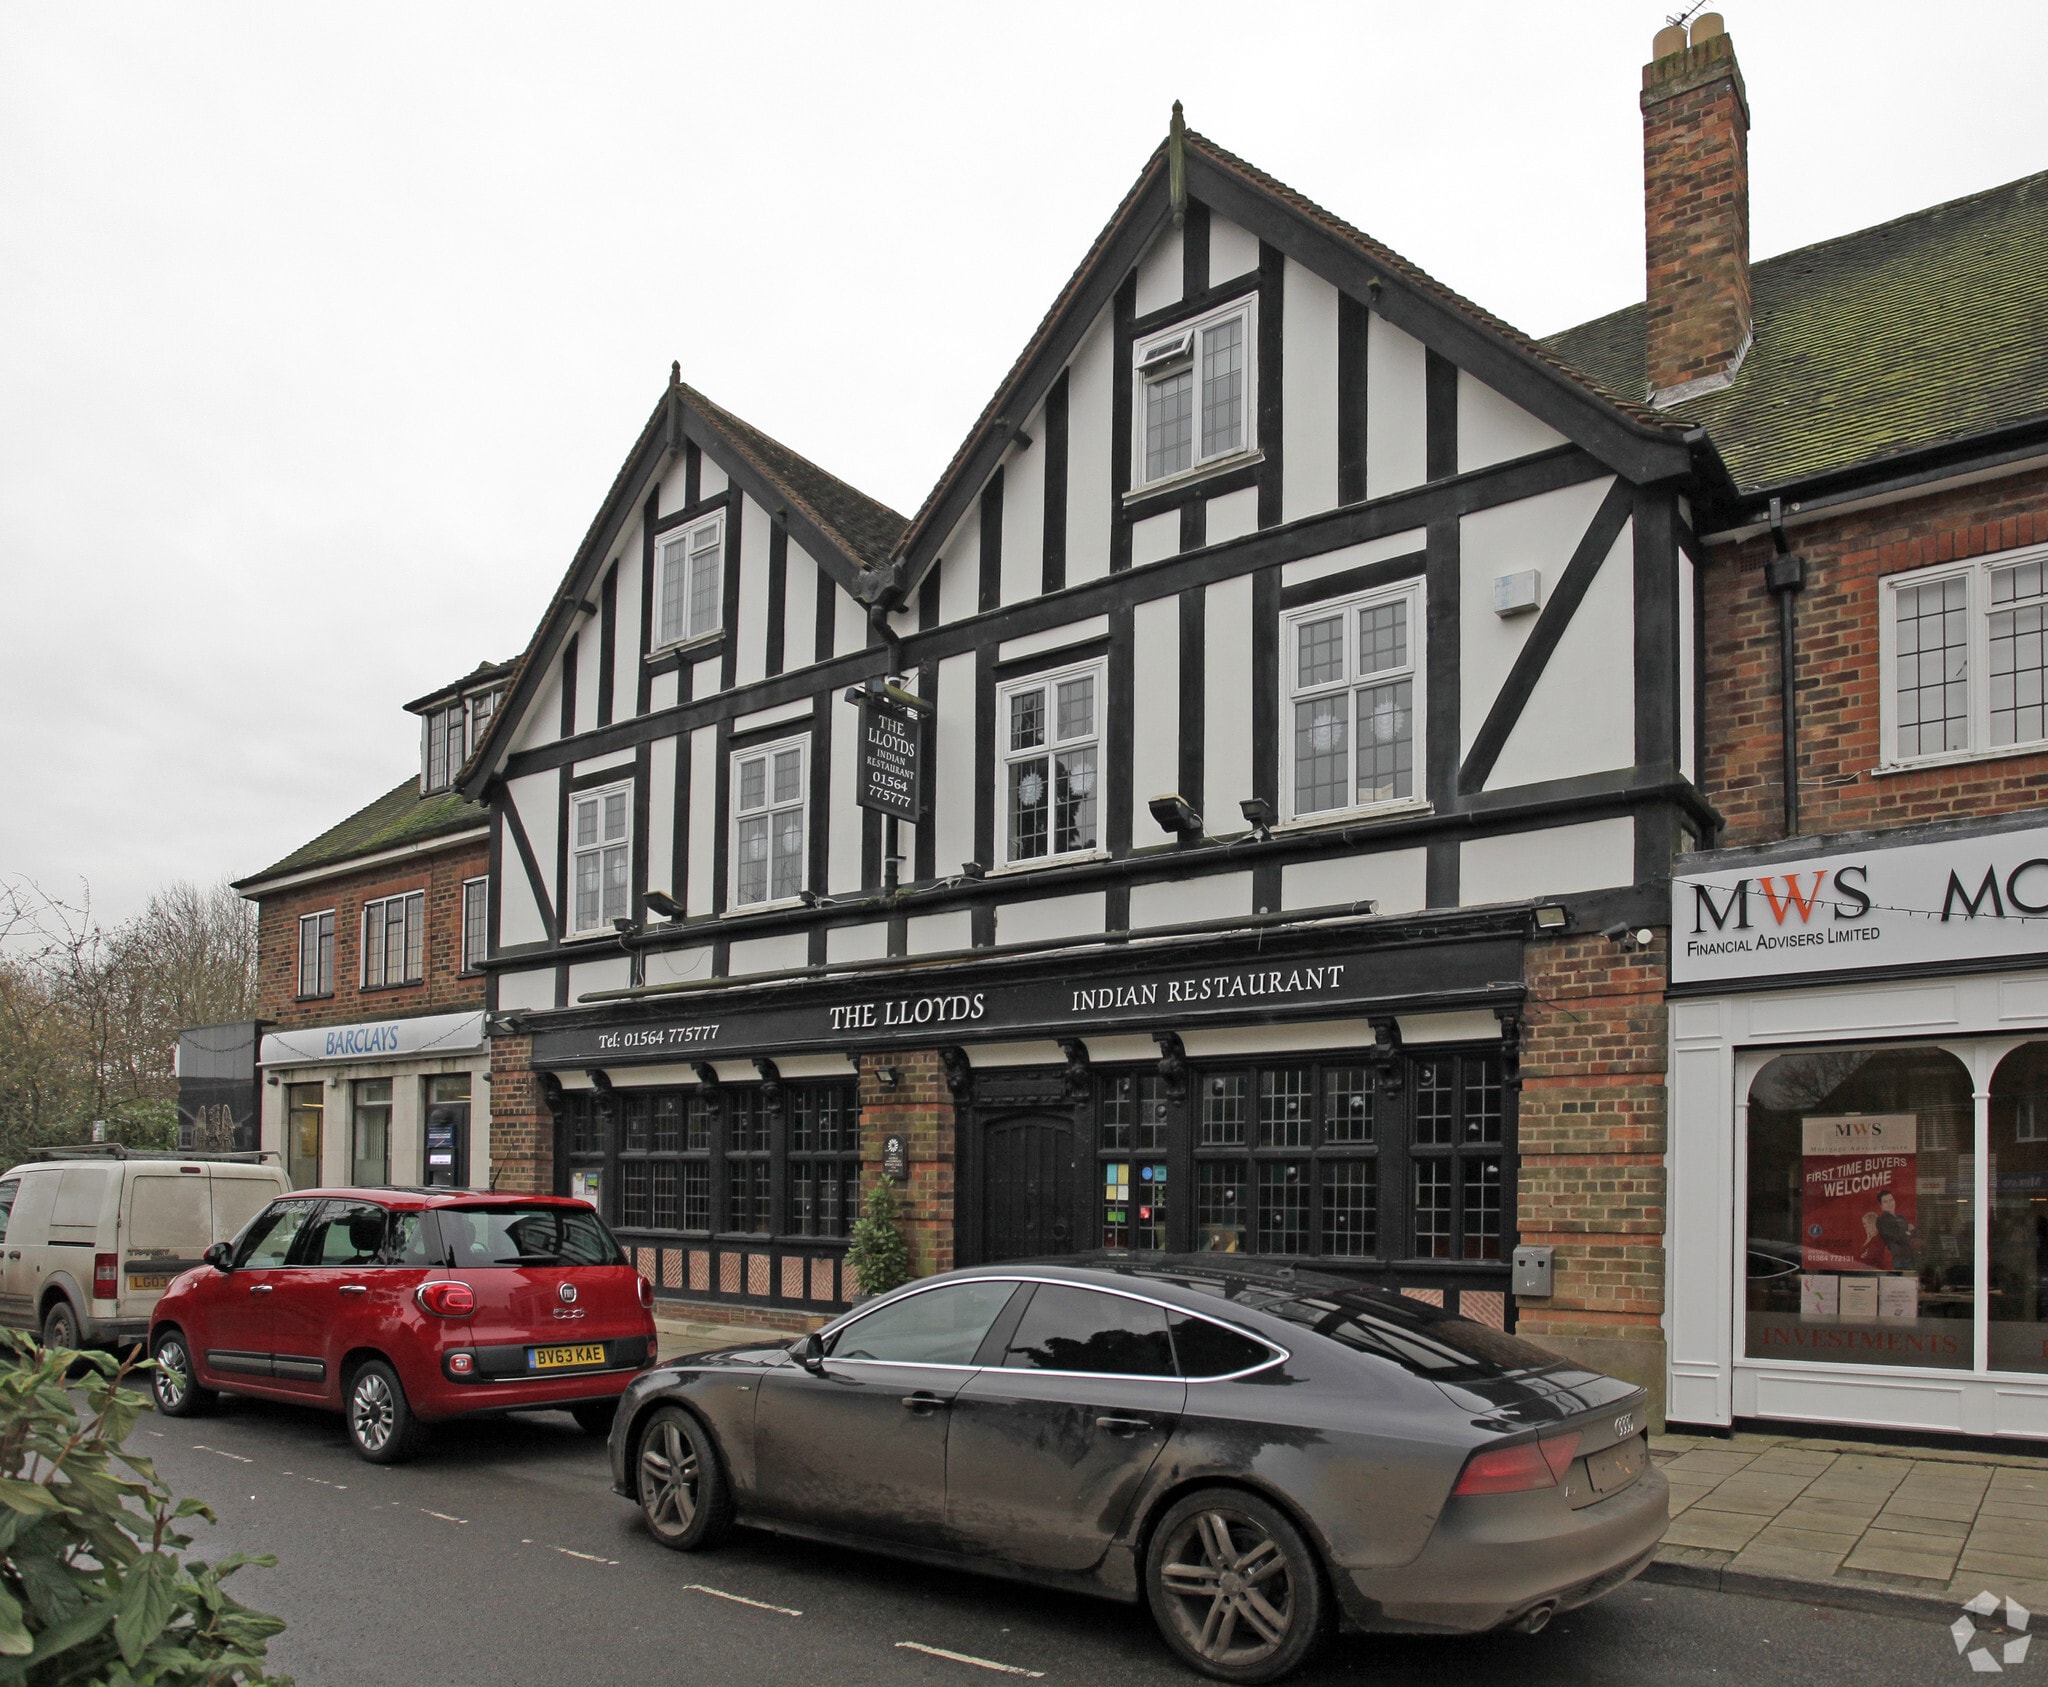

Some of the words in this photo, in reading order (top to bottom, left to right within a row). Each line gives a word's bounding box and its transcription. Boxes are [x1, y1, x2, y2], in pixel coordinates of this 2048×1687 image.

[878, 714, 905, 737] THE
[868, 727, 915, 758] LLOYDS
[866, 756, 914, 780] RESTAURANT
[877, 748, 906, 766] INDIAN
[872, 771, 908, 792] 01564
[868, 784, 911, 808] 775777
[1689, 864, 1871, 934] MWS
[1687, 941, 1753, 957] FINANCIAL
[1755, 932, 1825, 950] ADVISERS
[1827, 927, 1881, 944] LIMITED
[1071, 983, 1158, 1011] INDIAN
[1167, 965, 1345, 1002] RESTAURANT
[829, 1003, 876, 1030] THE
[884, 993, 985, 1025] LLOYDS
[326, 1025, 399, 1055] BARCLAYS
[598, 1033, 621, 1049] Tel:
[623, 1029, 665, 1047] 01564
[668, 1024, 720, 1043] 775777
[1835, 1122, 1882, 1137] MWS
[1806, 1168, 1835, 1182] FIRST
[1837, 1161, 1862, 1178] TIME
[1865, 1157, 1907, 1171] BUYERS
[1824, 1170, 1892, 1197] WELCOME
[1763, 1327, 1959, 1355] INVESTMENTS
[537, 1349, 573, 1365] BV63
[576, 1346, 602, 1362] KAE
